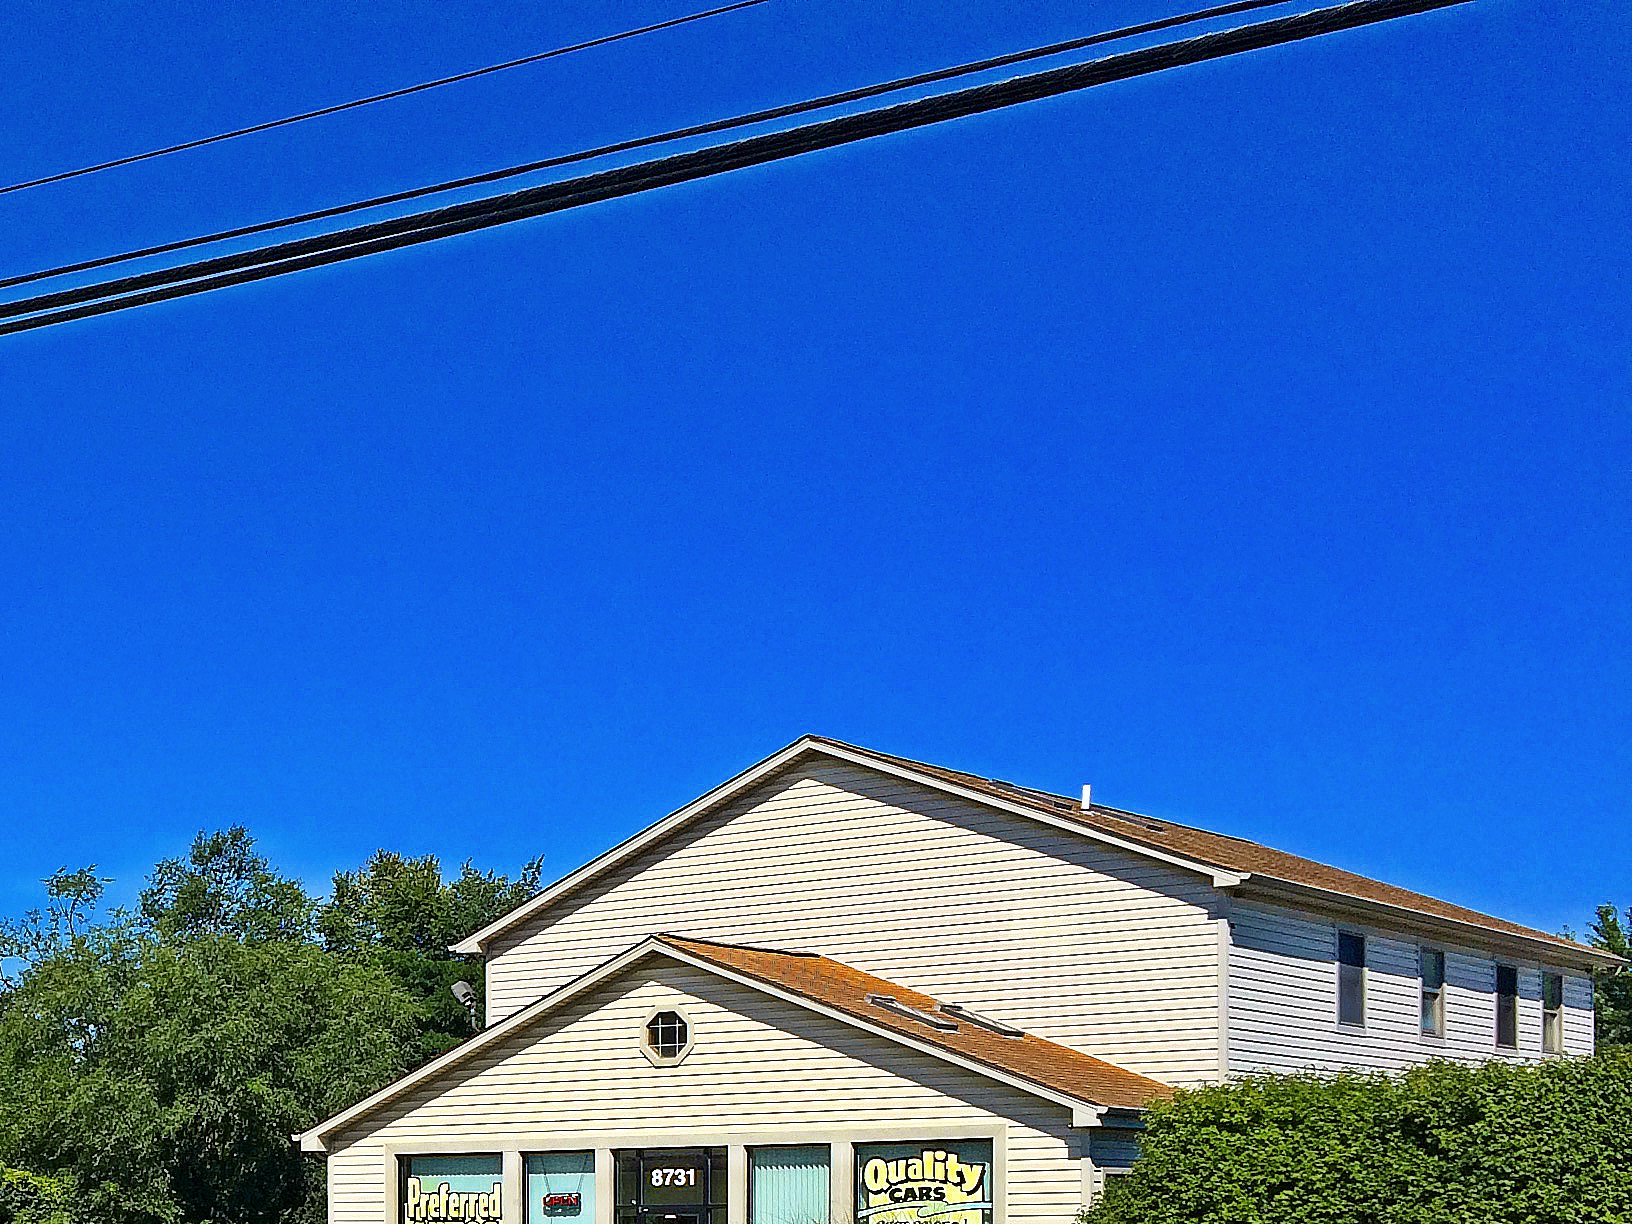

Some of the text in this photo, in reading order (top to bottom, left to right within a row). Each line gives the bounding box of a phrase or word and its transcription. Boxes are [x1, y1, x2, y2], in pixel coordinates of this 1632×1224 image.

[651, 1168, 696, 1187] 8731
[863, 1148, 986, 1196] Quality
[407, 1176, 503, 1220] Preferred
[889, 1186, 946, 1203] CARS
